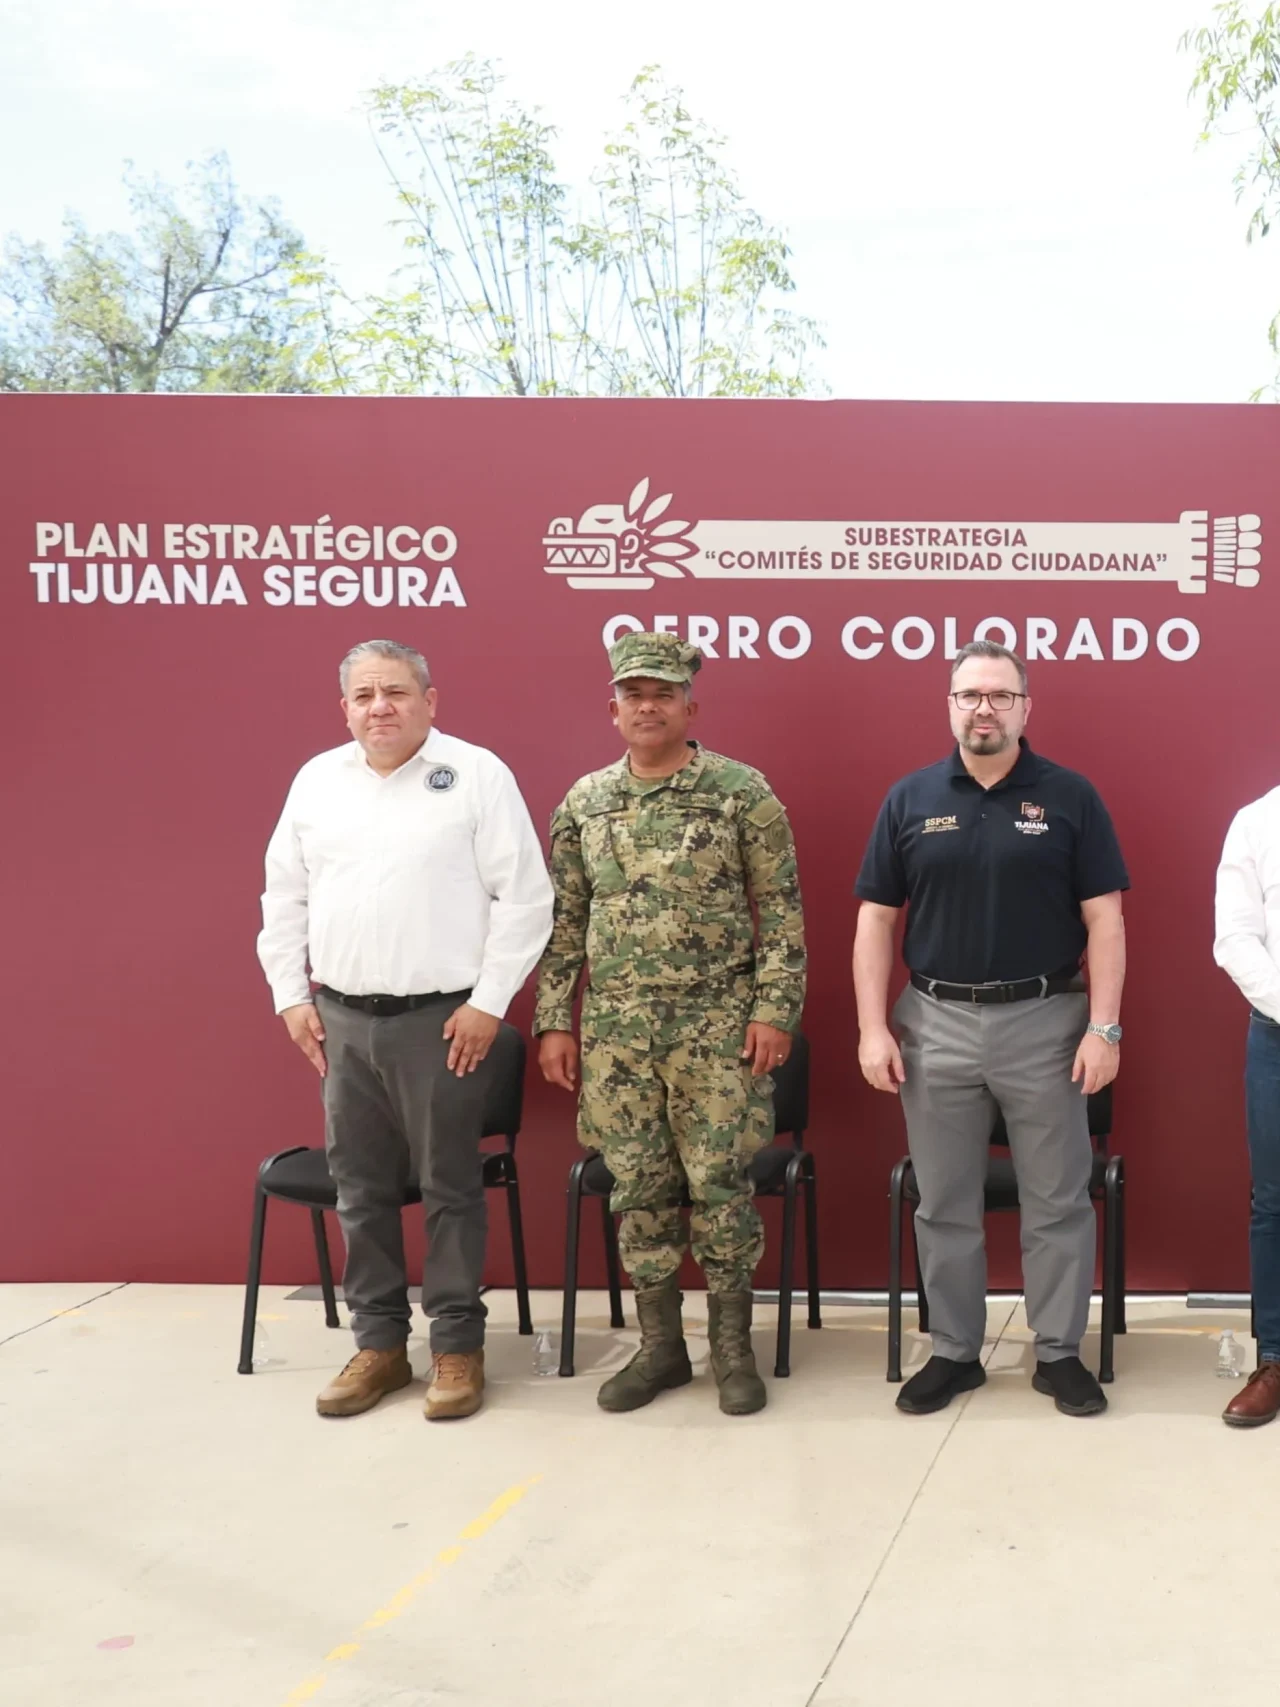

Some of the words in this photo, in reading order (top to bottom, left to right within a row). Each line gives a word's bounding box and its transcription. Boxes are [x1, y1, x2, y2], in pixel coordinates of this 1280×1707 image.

[36, 522, 148, 558] PLAN
[163, 514, 458, 562] ESTRATÉGICO
[844, 527, 1028, 547] SUBESTRATEGIA
[831, 551, 860, 570] DE
[867, 551, 1003, 571] SEGURIDAD
[29, 562, 248, 606] TIJUANA
[263, 564, 467, 607] SEGURA
[841, 615, 1200, 662] COLORADO
[924, 815, 957, 826] SSPCM
[1014, 821, 1049, 831] TIJUANA
